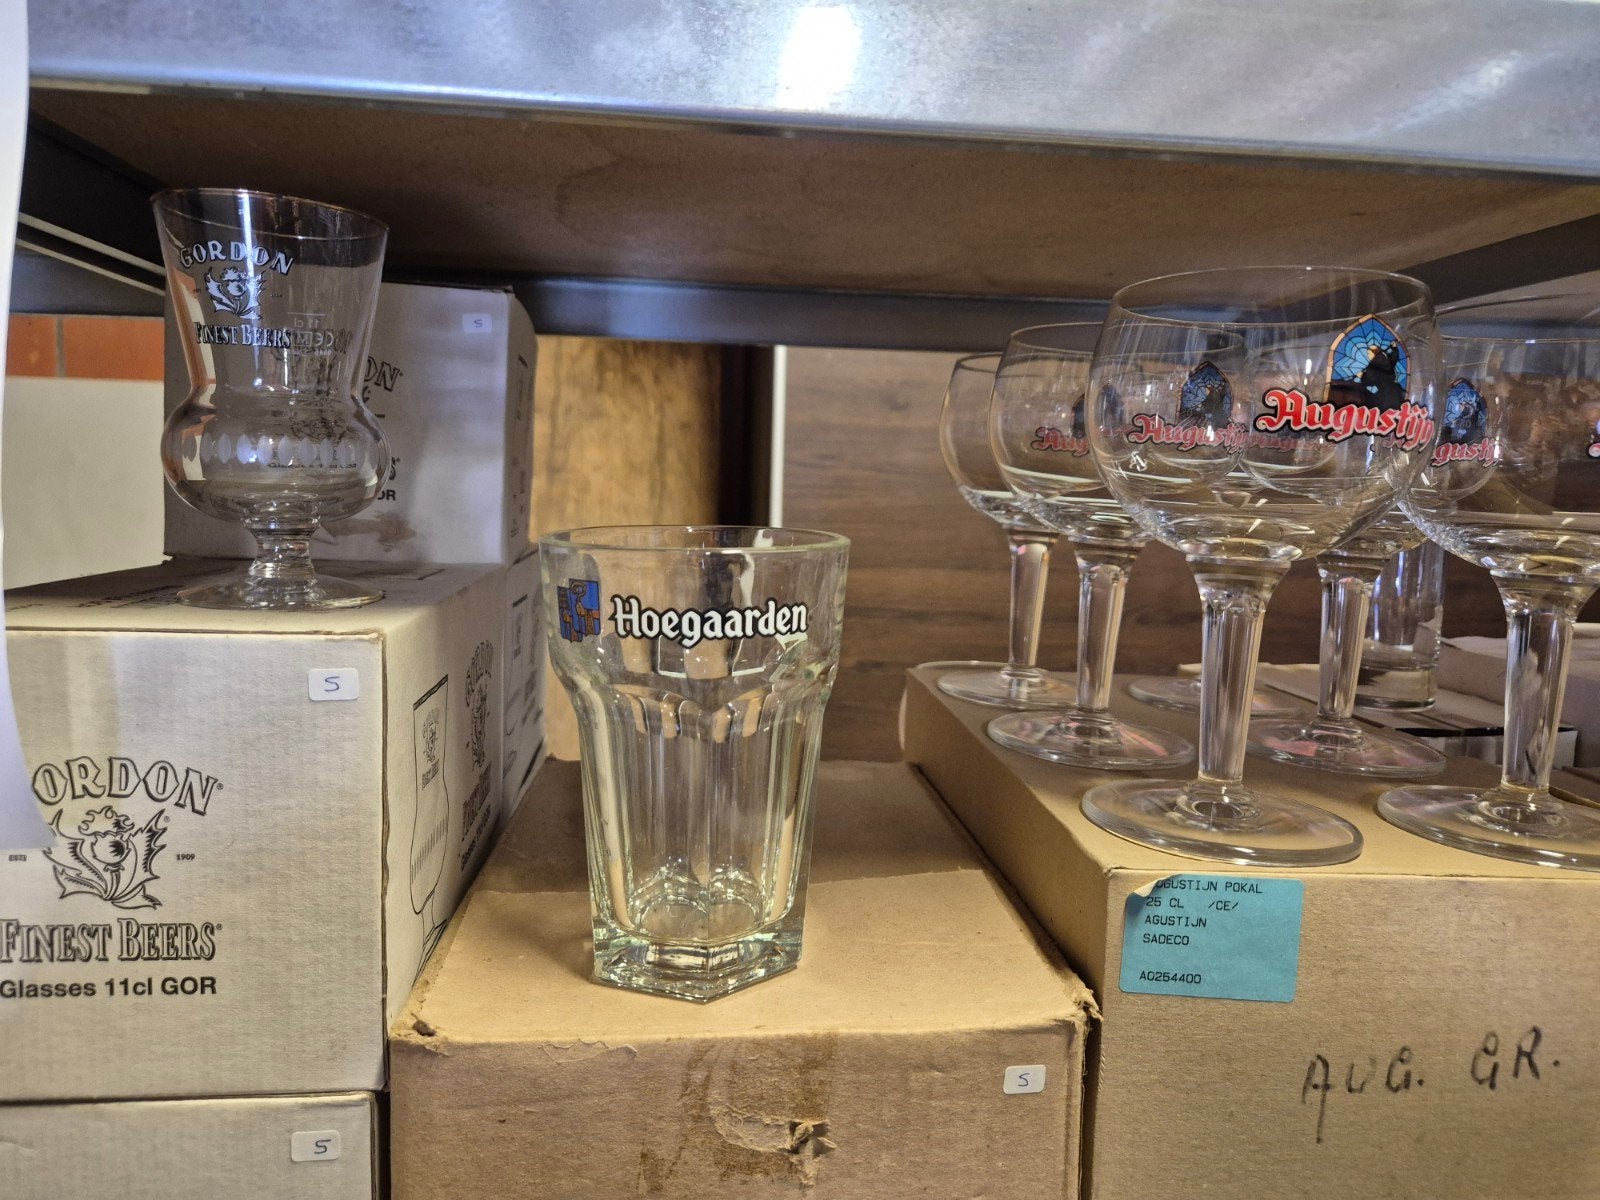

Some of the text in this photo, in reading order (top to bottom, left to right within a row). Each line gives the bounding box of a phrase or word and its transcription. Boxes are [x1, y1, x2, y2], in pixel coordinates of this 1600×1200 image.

[180, 240, 294, 275] GORDON
[240, 323, 292, 349] BEERS
[1255, 386, 1435, 452] Augustijn
[610, 594, 808, 650] Hoegaarden
[31, 755, 218, 816] ORDON
[1224, 881, 1263, 895] POKAL
[1145, 896, 1162, 908] 25
[1169, 897, 1185, 909] CL
[1144, 914, 1207, 928] AGUSTIJN
[0, 917, 217, 963] FINEST BEERS
[1142, 933, 1190, 946] SADECO
[0, 975, 218, 999] Glasses 11cl GOR
